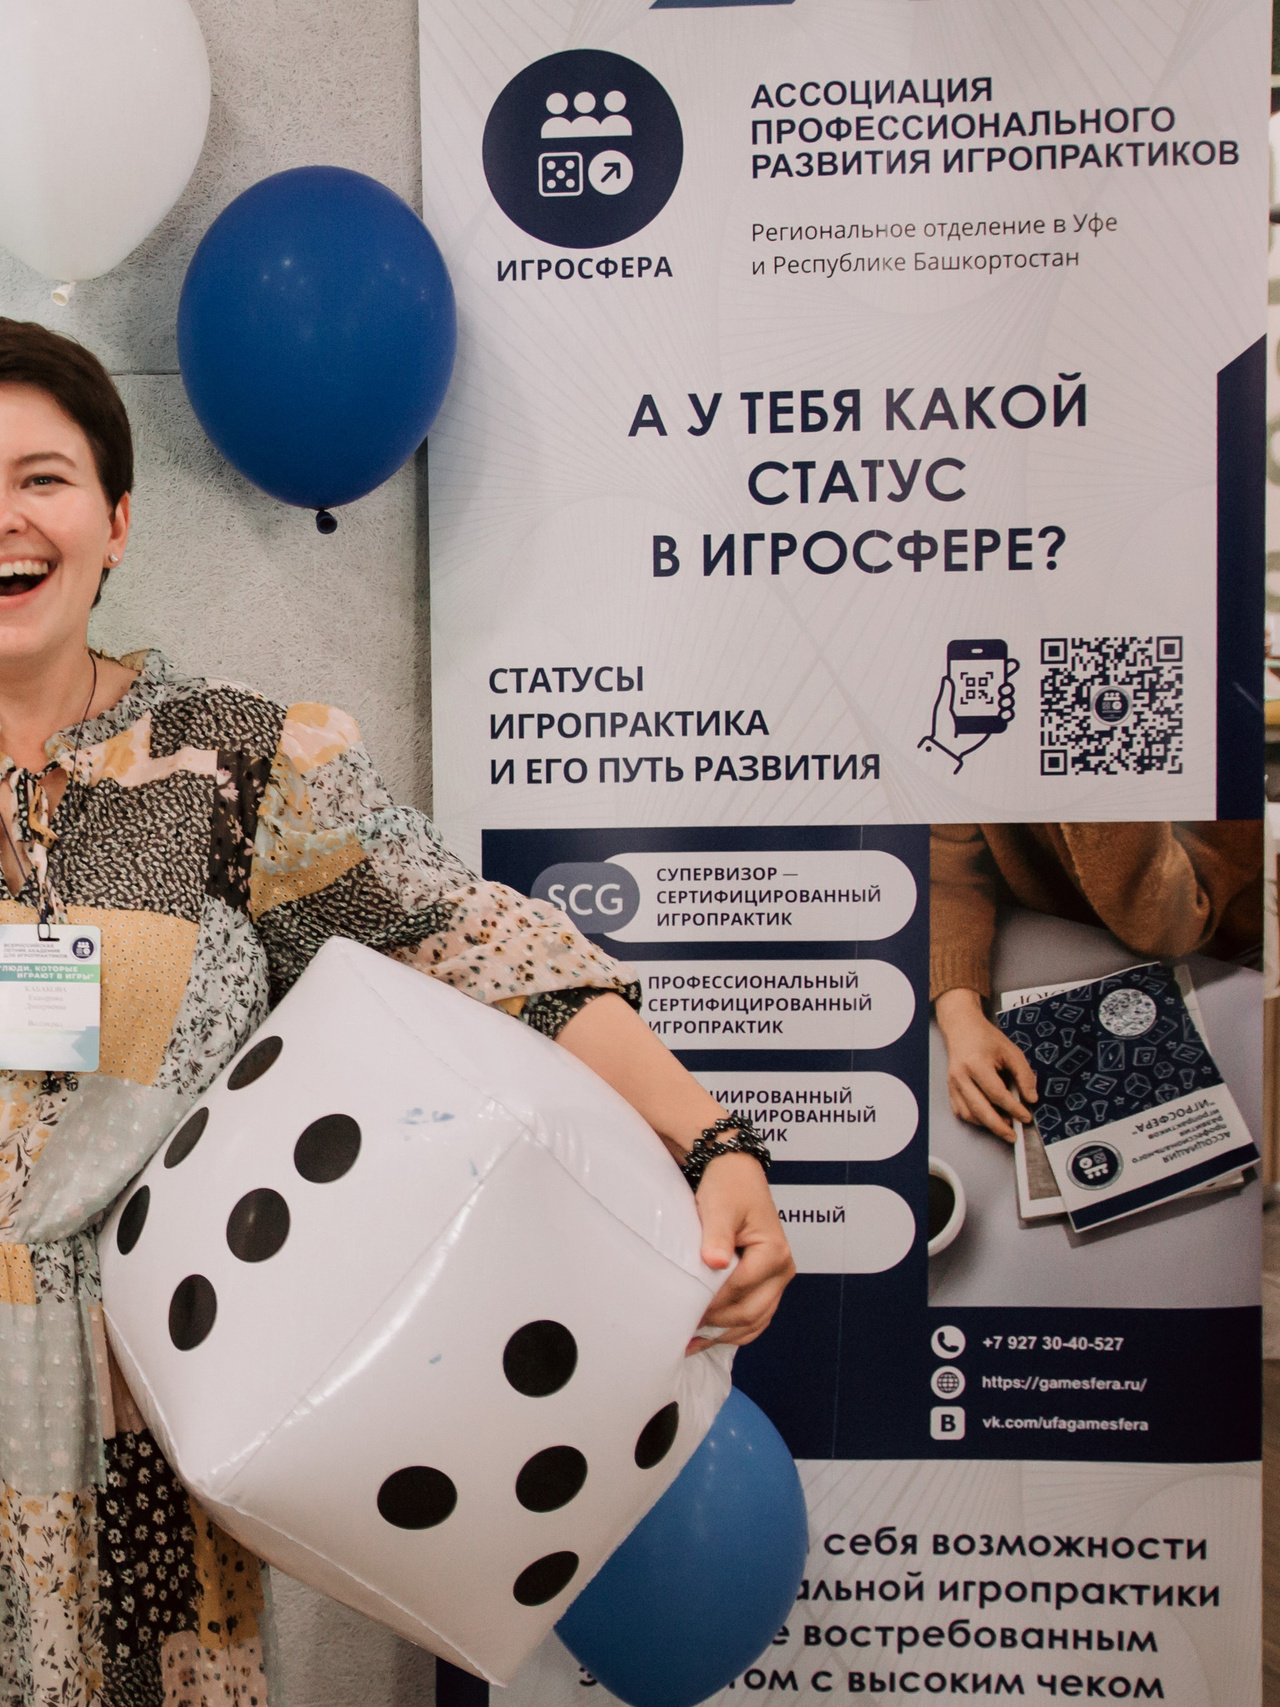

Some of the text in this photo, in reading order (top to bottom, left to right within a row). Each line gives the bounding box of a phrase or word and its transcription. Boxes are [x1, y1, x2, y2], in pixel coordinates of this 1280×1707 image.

[750, 76, 994, 110] АССОЦИАЦИЯ
[750, 106, 1177, 146] ПРОФЕССИОНАЛЬНОГО
[751, 139, 1239, 179] РАЗВИТИЯ ИГРОПРАКТИКОВ
[752, 212, 1118, 242] Региональное отделение в Уфе
[497, 256, 673, 282] ИГРОСФЕРА
[752, 251, 1079, 279] и Республике Башкортостан
[627, 371, 1087, 437] А У ТЕБЯ КАКОЙ
[747, 457, 966, 506] СТАТУС
[652, 525, 1066, 578] В ИГРОСФЕРЕ?
[488, 665, 643, 694] СТАТУСЫ
[490, 709, 770, 740] ИГРОПРАКТИКА
[490, 753, 880, 785] И ЕГО ПУТЬ РАЗВИТИЯ
[656, 867, 778, 882] СУПЕРВИЗОР
[547, 883, 624, 916] SCG
[656, 884, 881, 907] СЕРТИФИЦИРОВАННЫЙ
[657, 912, 792, 927] ИГРОПРАКТИК
[648, 971, 859, 990] ПРОФЕССИОНАЛЬНЫЙ
[648, 993, 872, 1015] СЕРТИФИЦИРОВАННЫЙ
[647, 1019, 784, 1035] ИГРОПРАКТИК
[982, 1335, 1124, 1351] +7 927 30-40-527
[982, 1375, 1148, 1392] https://gamesfera.ru/
[982, 1415, 1149, 1433] vk.com/ufagamesfera
[823, 1526, 1207, 1561] себя возможности
[939, 1580, 1220, 1611] игропрактики
[803, 1618, 1158, 1655] востребованным
[810, 1670, 833, 1693] с
[847, 1671, 1025, 1695] высоким
[1037, 1674, 1165, 1699] чеком
